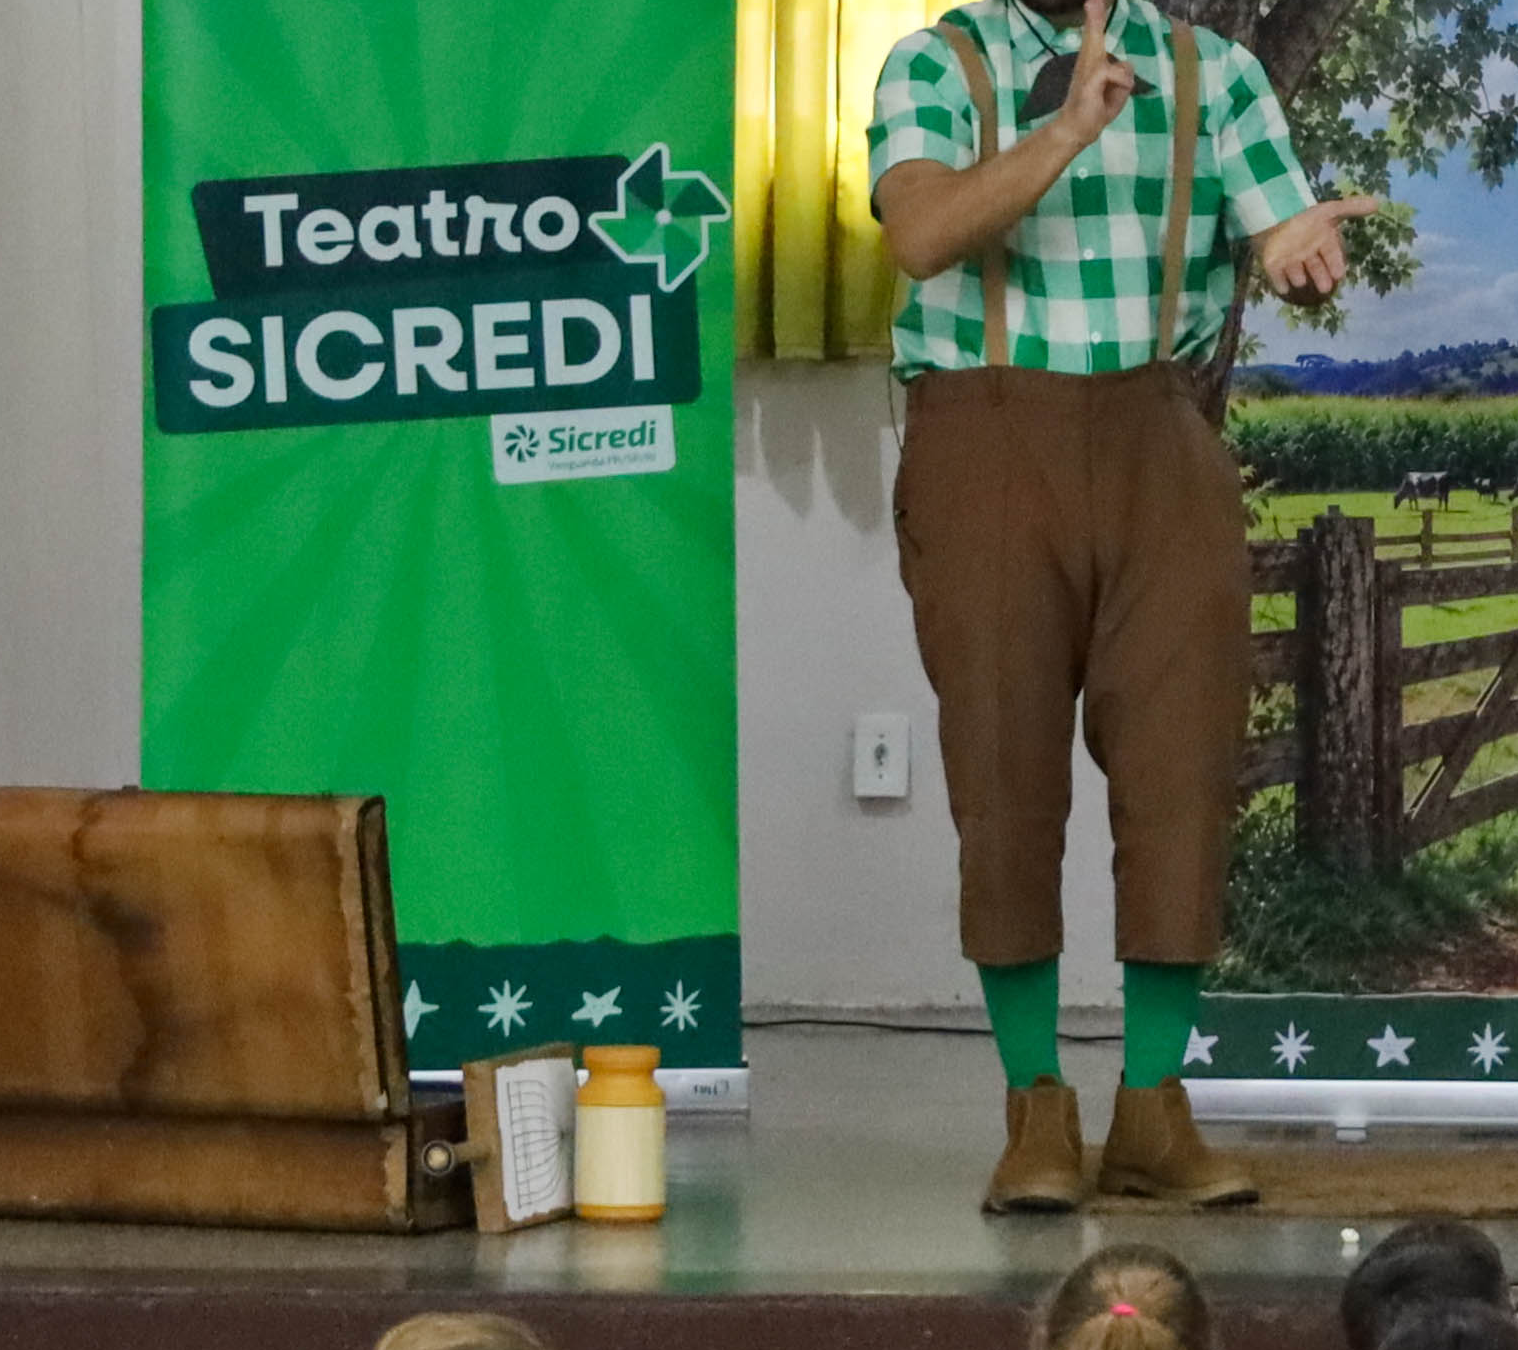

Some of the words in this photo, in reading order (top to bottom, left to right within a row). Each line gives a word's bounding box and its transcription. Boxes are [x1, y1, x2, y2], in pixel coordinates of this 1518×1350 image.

[244, 190, 580, 268] Teatro
[188, 295, 656, 408] SICREDI
[548, 420, 656, 455] Sicredi
